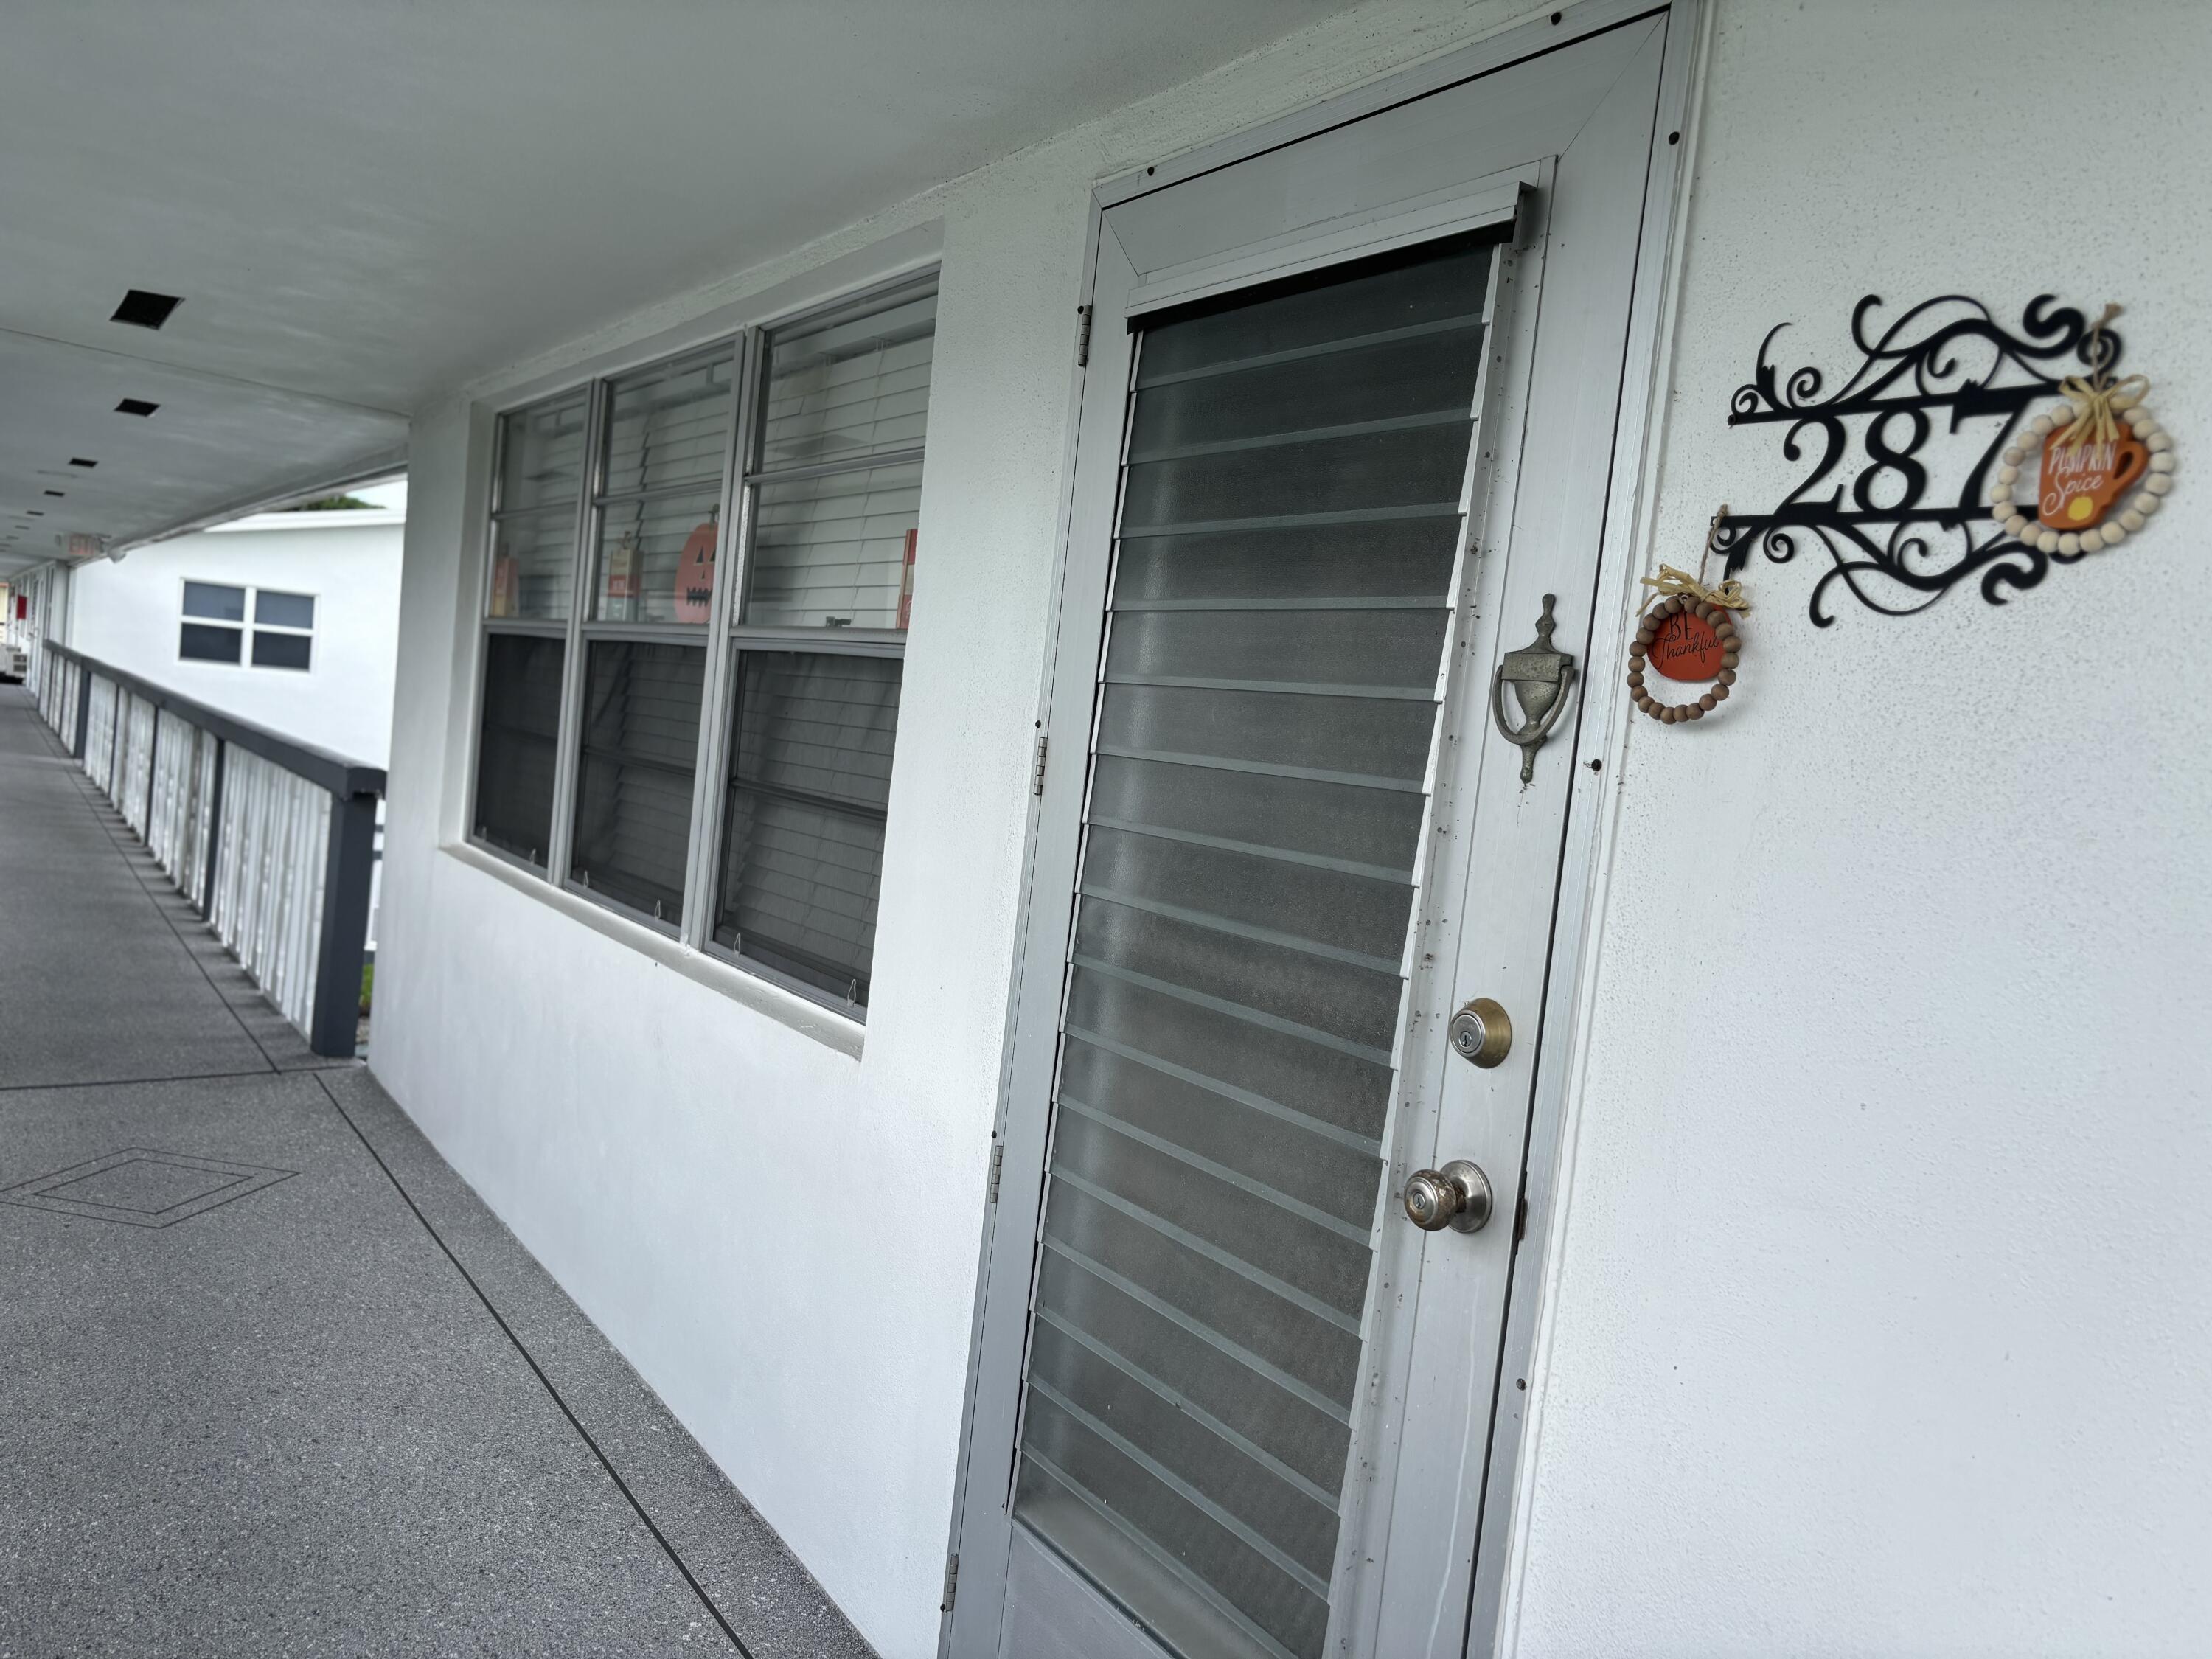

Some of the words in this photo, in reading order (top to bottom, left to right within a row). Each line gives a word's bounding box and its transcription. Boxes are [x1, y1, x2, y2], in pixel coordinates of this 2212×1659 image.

[1773, 400, 2033, 515] 287
[2042, 467, 2102, 515] Spice
[1669, 611, 1694, 640] BE
[1652, 632, 1719, 669] Thankful
